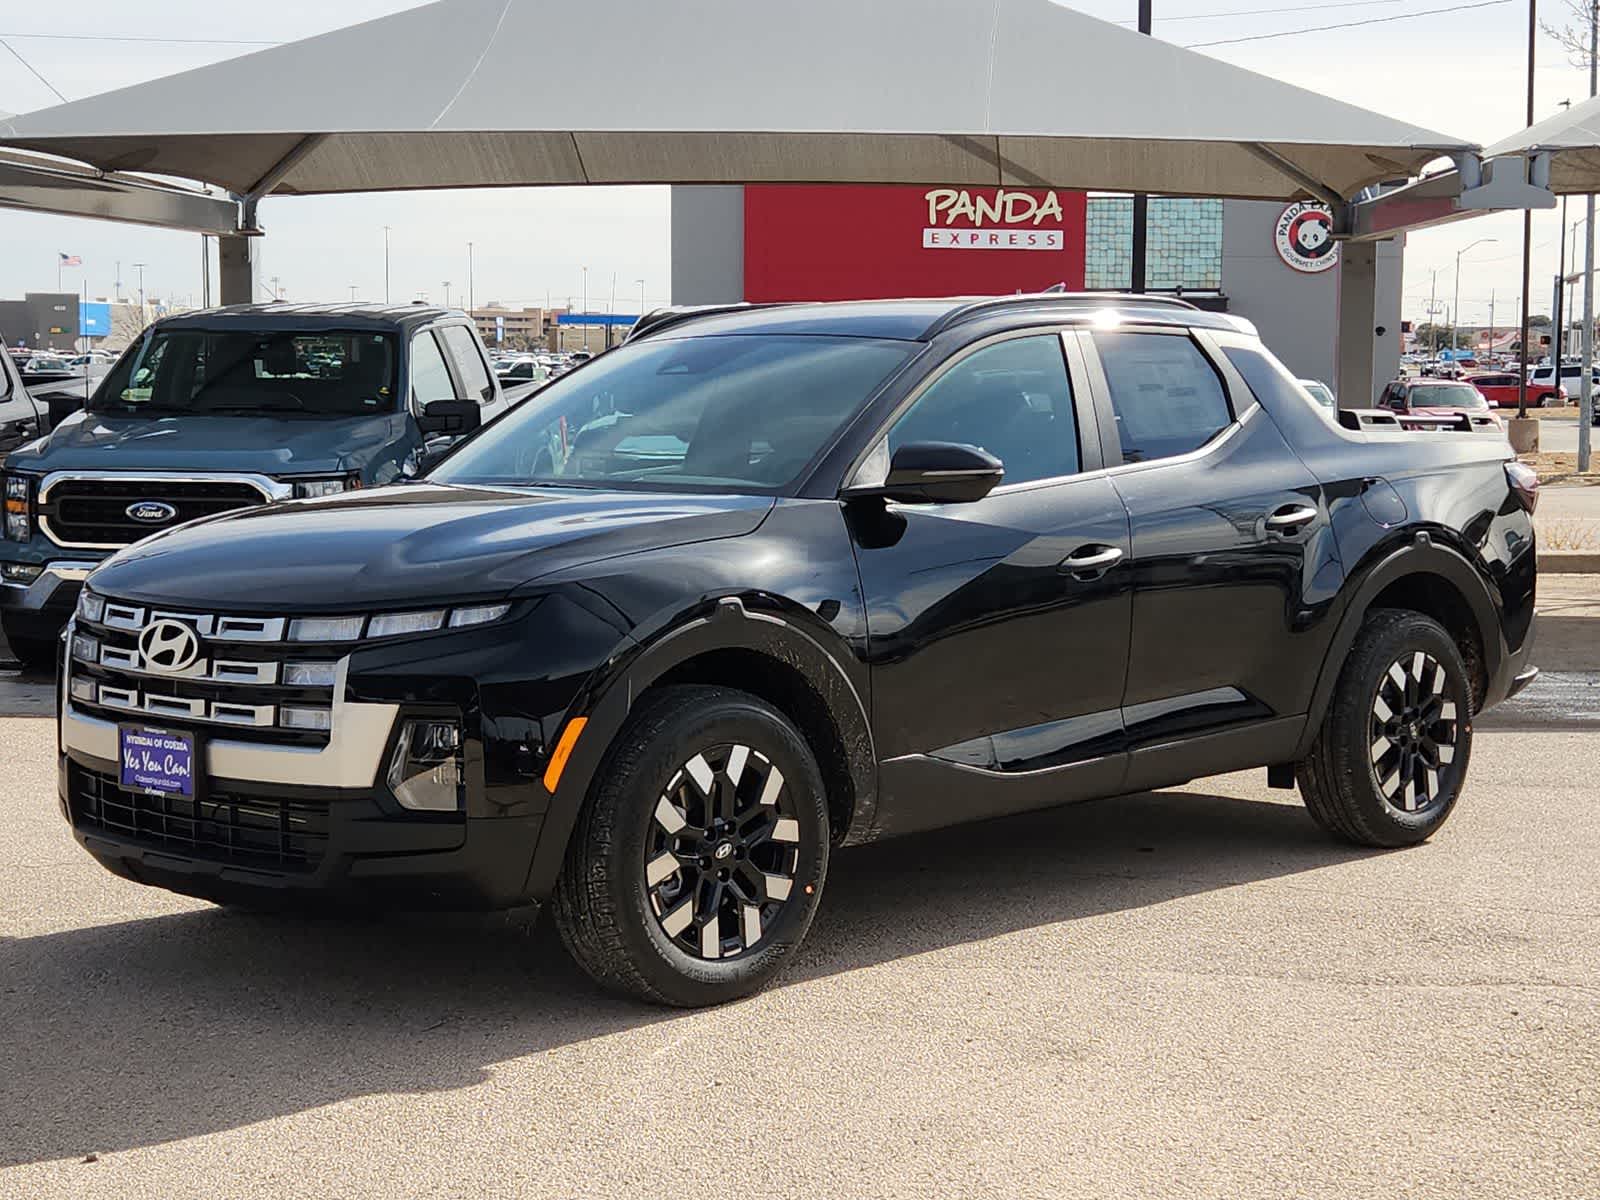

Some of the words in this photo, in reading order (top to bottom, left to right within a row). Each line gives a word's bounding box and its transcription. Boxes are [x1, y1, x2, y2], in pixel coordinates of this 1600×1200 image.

[925, 189, 1063, 227] PANDA
[1279, 203, 1307, 236] PANDA
[931, 233, 1056, 246] EXPRESS
[136, 506, 164, 518] Ford
[123, 748, 140, 770] Yes
[142, 751, 162, 771] You
[164, 754, 191, 777] Can!
